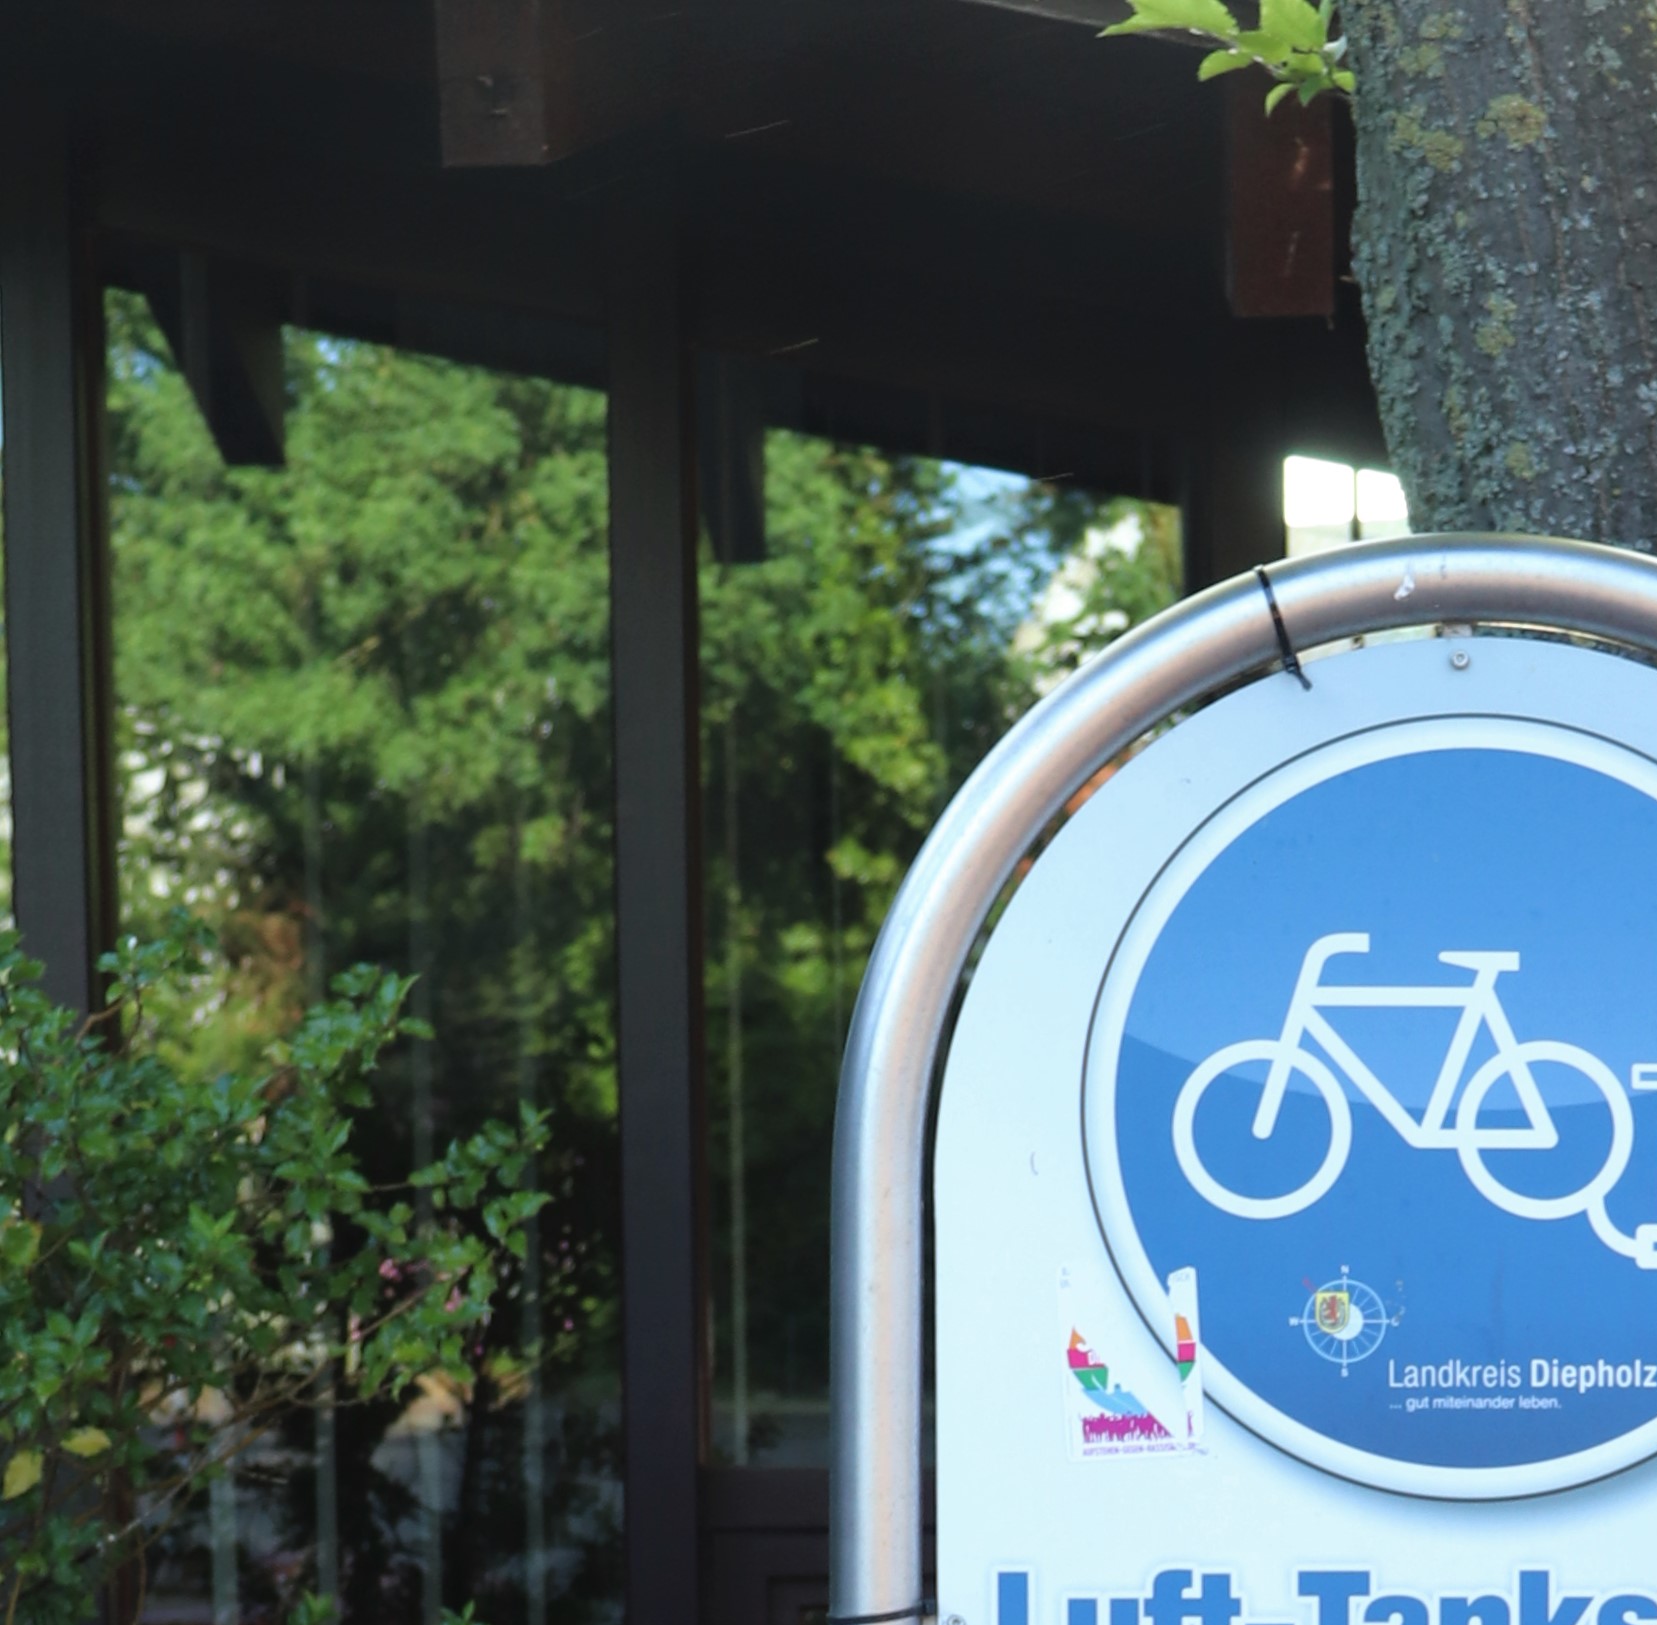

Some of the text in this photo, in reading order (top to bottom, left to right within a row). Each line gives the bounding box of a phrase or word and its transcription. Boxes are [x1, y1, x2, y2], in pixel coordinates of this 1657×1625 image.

[1388, 1359, 1522, 1388] Landkreis
[1406, 1396, 1430, 1412] gut
[1433, 1396, 1515, 1409] miteinander
[1519, 1396, 1562, 1410] leben.
